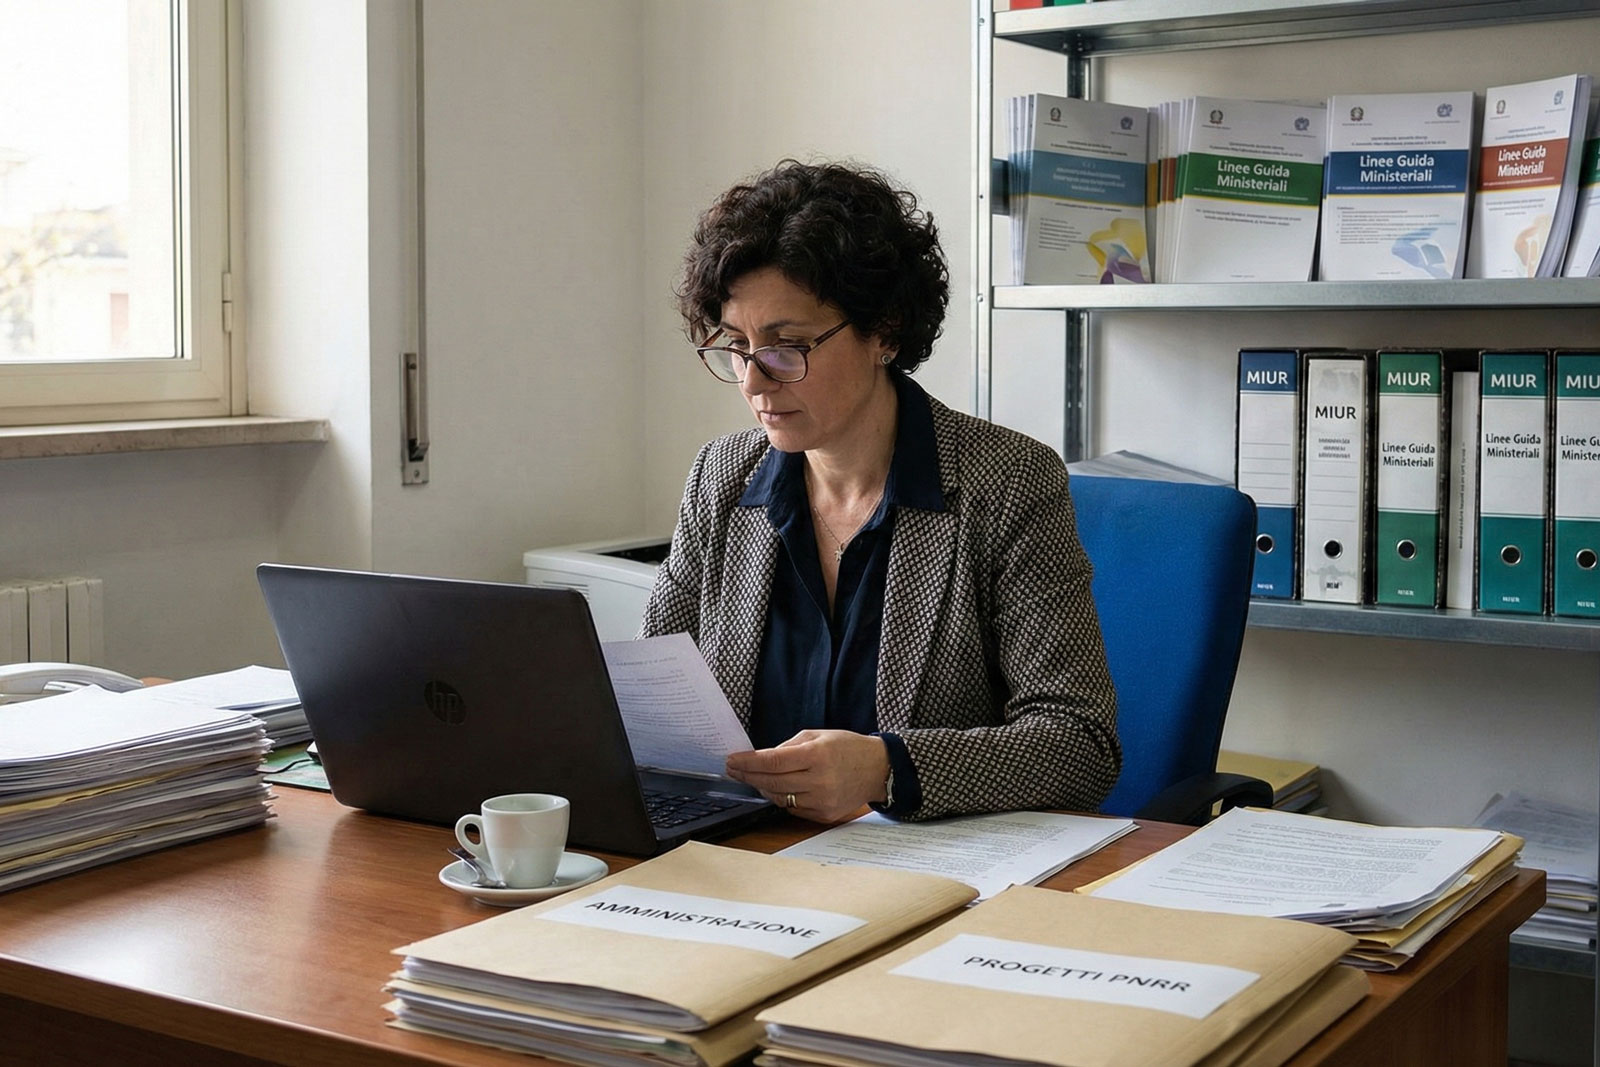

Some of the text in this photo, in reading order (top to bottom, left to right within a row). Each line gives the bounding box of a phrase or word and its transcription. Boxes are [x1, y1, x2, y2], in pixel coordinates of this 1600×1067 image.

[1360, 154, 1434, 167] Linee Guida
[1498, 145, 1546, 162] Linee Guida
[1217, 160, 1290, 178] Linee Guida
[1360, 169, 1432, 183] Ministeriali
[1497, 161, 1544, 177] Ministeriali
[1217, 174, 1288, 192] Ministeriali
[1246, 370, 1288, 385] MIUR
[1387, 371, 1431, 386] MIUR
[1491, 373, 1537, 388] MIUR
[1314, 405, 1357, 419] MIUR
[1485, 433, 1541, 444] Linee Guida
[1560, 435, 1587, 446] Linee
[1382, 442, 1435, 454] Linee Guida
[1486, 447, 1540, 458] Ministeriali
[1383, 455, 1434, 467] Ministeriali
[584, 901, 821, 939] AMMINISTRAZIONE
[963, 956, 1192, 993] PROGETTI PNRR
